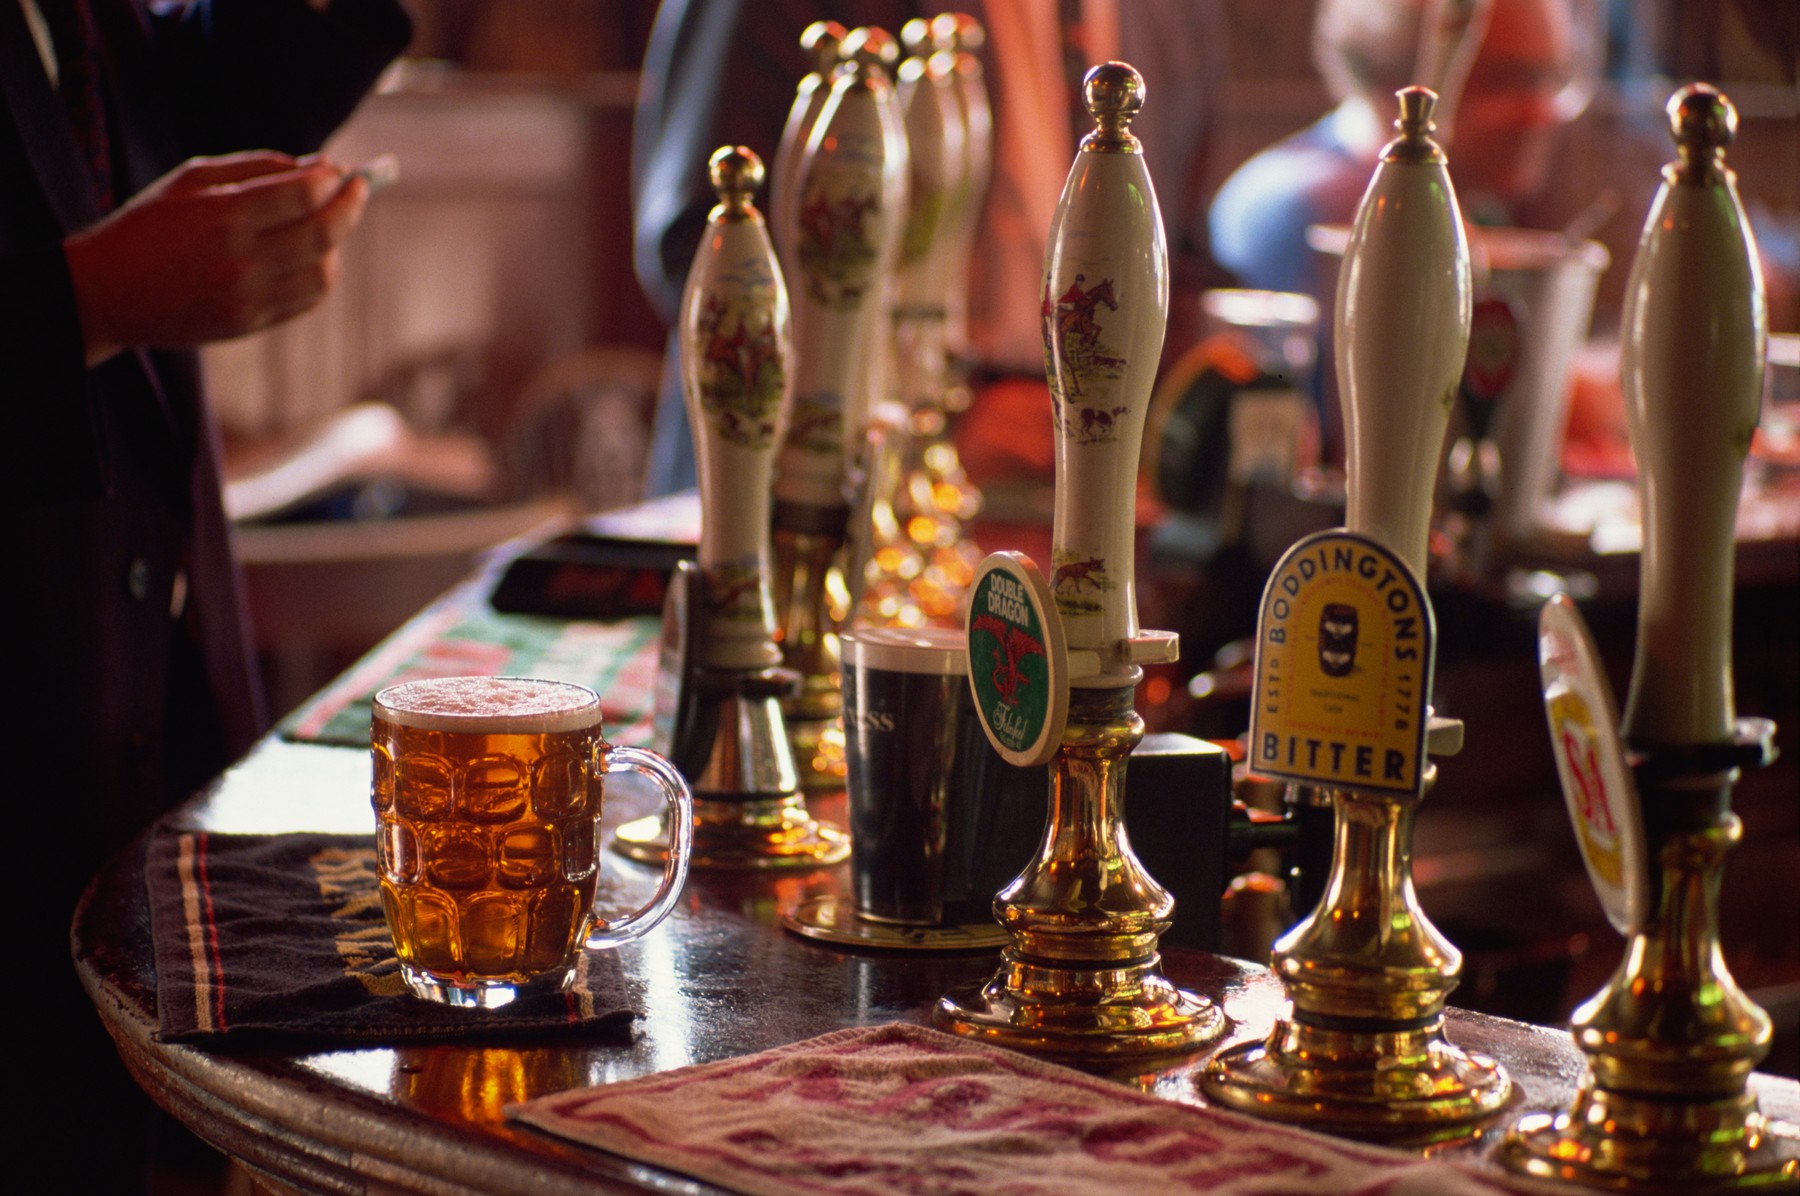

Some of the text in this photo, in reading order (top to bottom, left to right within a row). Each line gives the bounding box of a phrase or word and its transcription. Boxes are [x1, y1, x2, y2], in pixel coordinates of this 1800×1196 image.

[988, 590, 1029, 627] DRAGON
[991, 573, 1024, 604] DOUBLE
[1268, 548, 1419, 662] BODDINGTONS
[1262, 732, 1406, 781] BITTER
